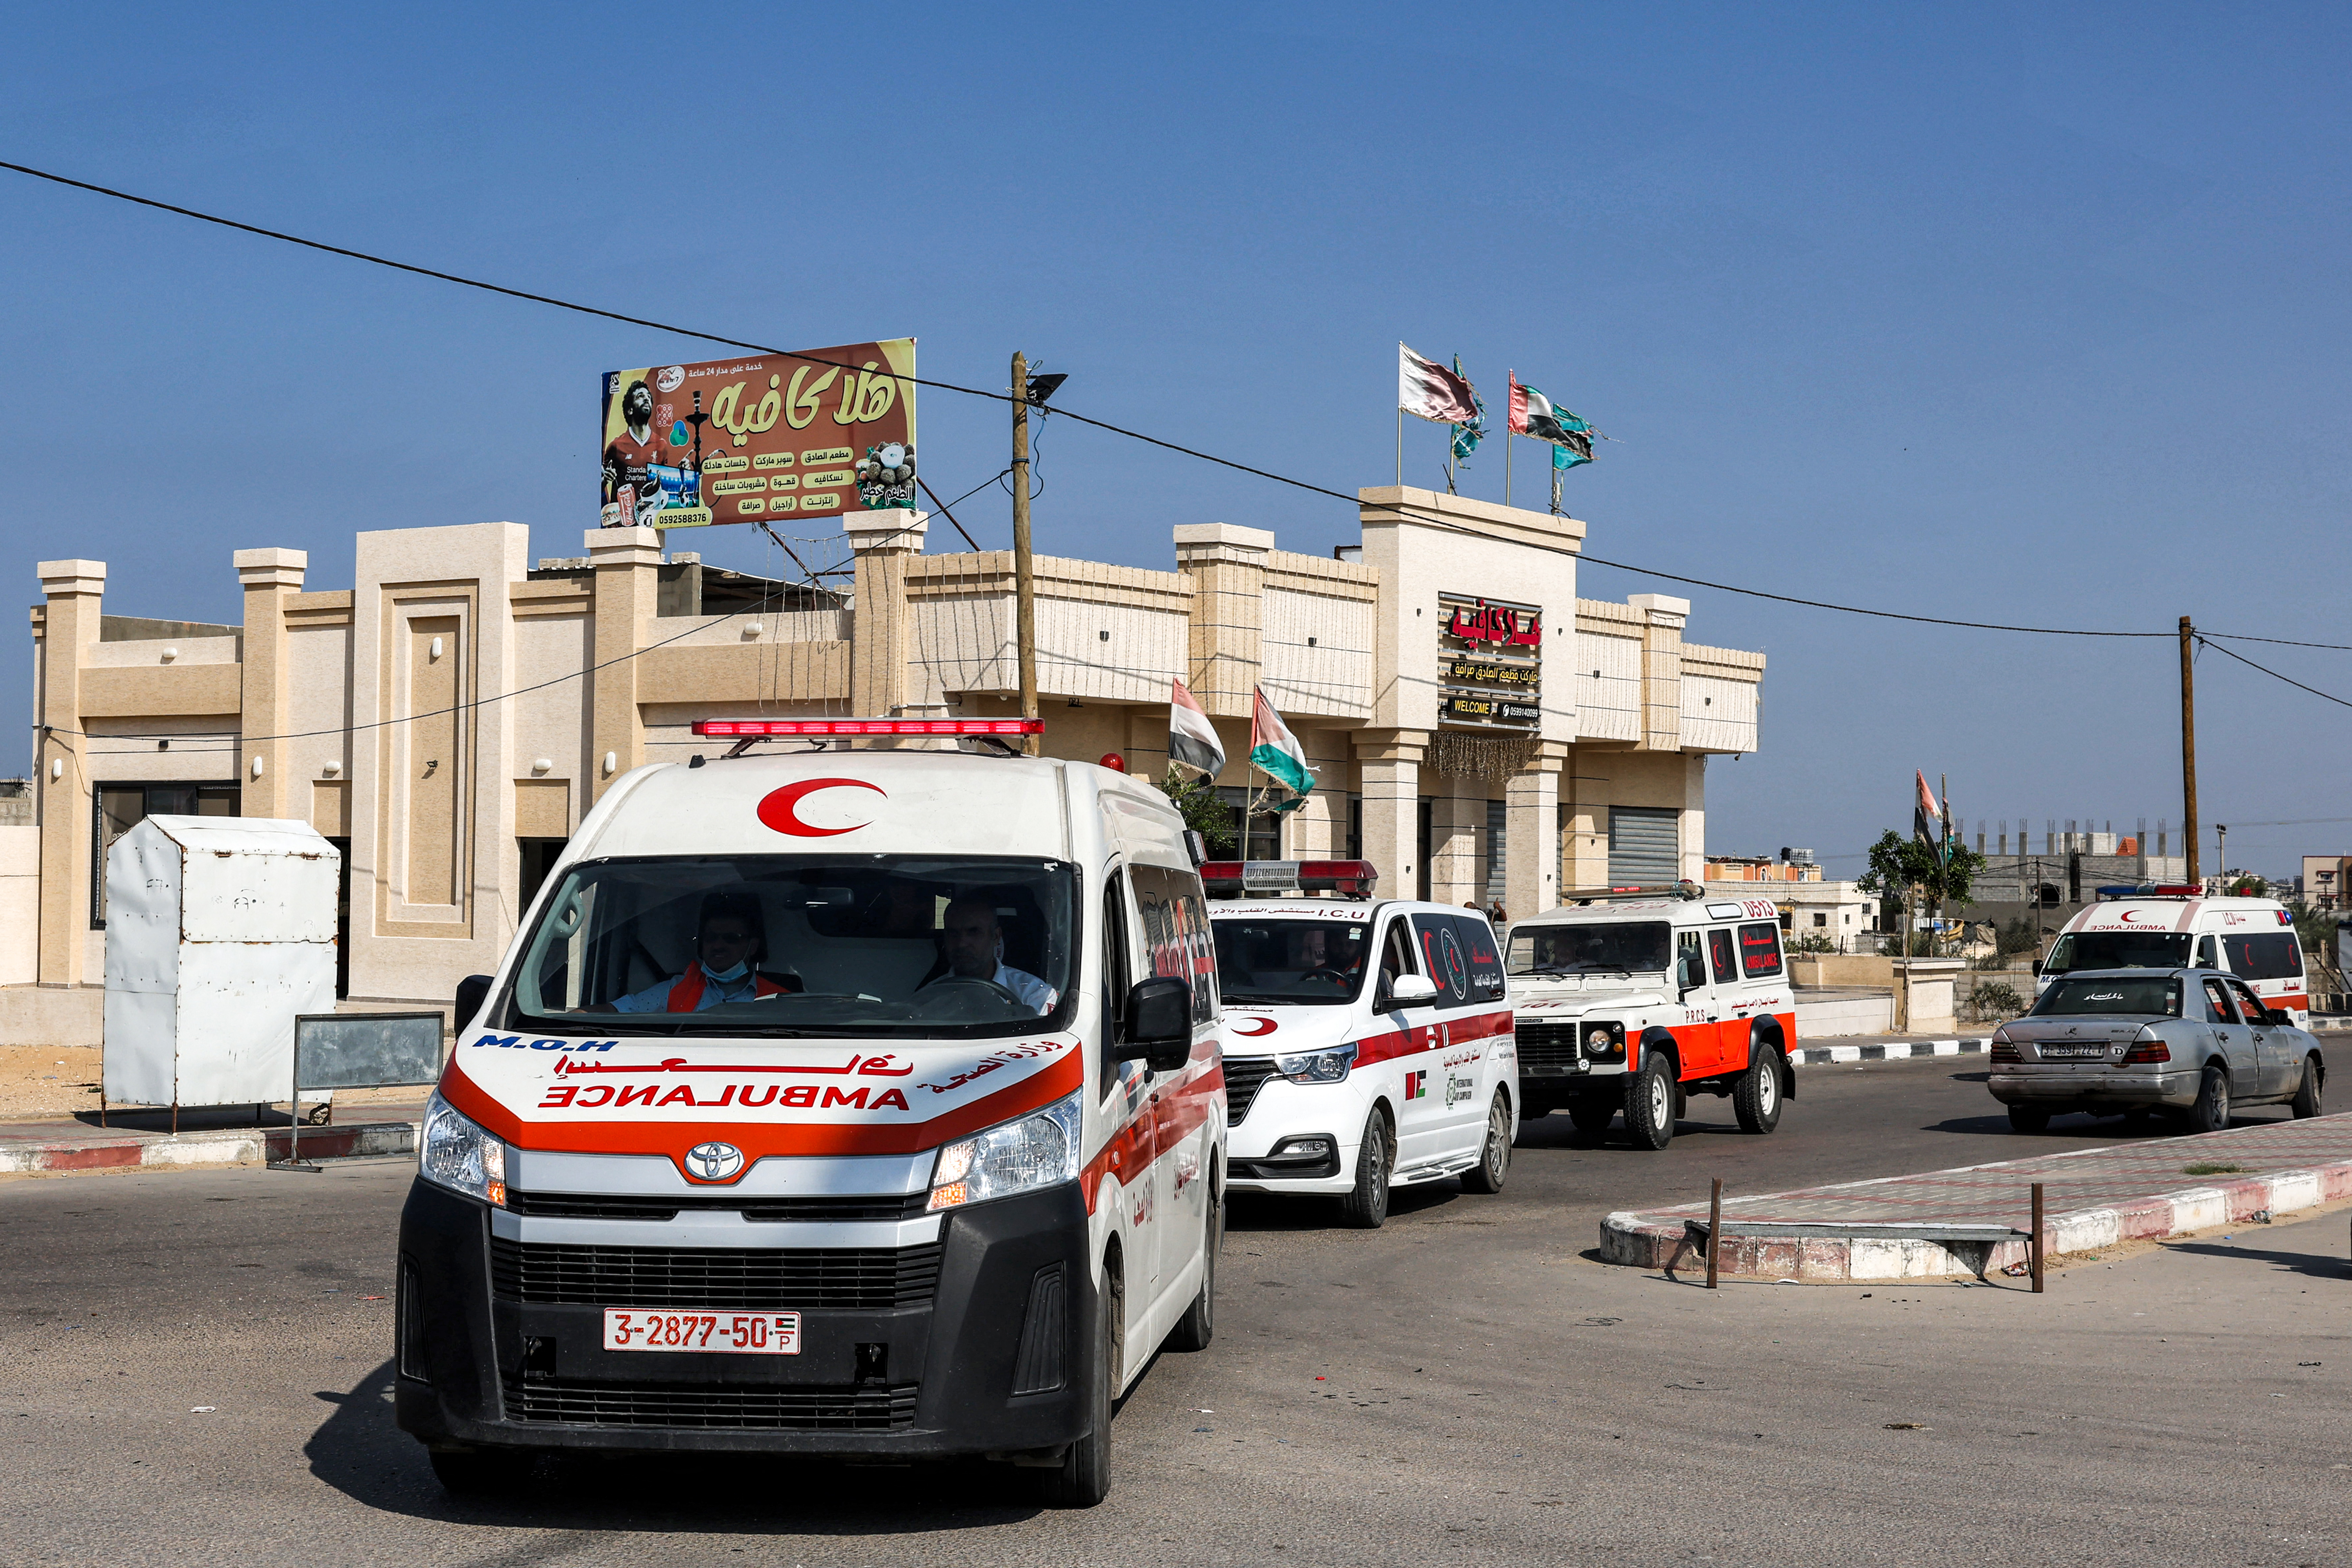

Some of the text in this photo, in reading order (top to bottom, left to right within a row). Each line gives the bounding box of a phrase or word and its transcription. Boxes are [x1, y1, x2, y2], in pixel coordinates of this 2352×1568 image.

[715, 367, 728, 376] مدار
[730, 364, 743, 374] على
[746, 362, 762, 370] خدمة
[711, 361, 895, 447] هلا كافيه
[755, 456, 792, 465] سوبر ماركت
[805, 450, 849, 463] مطعم الصادق
[704, 460, 747, 470] جلسات هادئة
[714, 478, 765, 491] مشروبات ساخنة
[773, 477, 796, 487] قهوة
[814, 474, 843, 485] نسكافيه
[807, 495, 833, 507] إنترنت
[885, 485, 913, 505] الطعم
[742, 502, 760, 510] صرافة
[772, 497, 793, 511] أراجيل
[659, 513, 706, 524] 0592588376
[1450, 598, 1540, 650] هلا كافيه
[1455, 663, 1538, 684] ماركت مطعم الصادق صرافة
[1455, 700, 1490, 714] WELCOME
[1510, 707, 1538, 717] 0599140099
[1318, 909, 1365, 919] I.C.U
[1746, 953, 1779, 969] AMBULANCE
[1686, 1009, 1705, 1024] P.R.C.S
[472, 1034, 619, 1052] M.O.H
[916, 1040, 1063, 1094] وزارة الصحة
[615, 1314, 790, 1350] 3-2877-50 P
